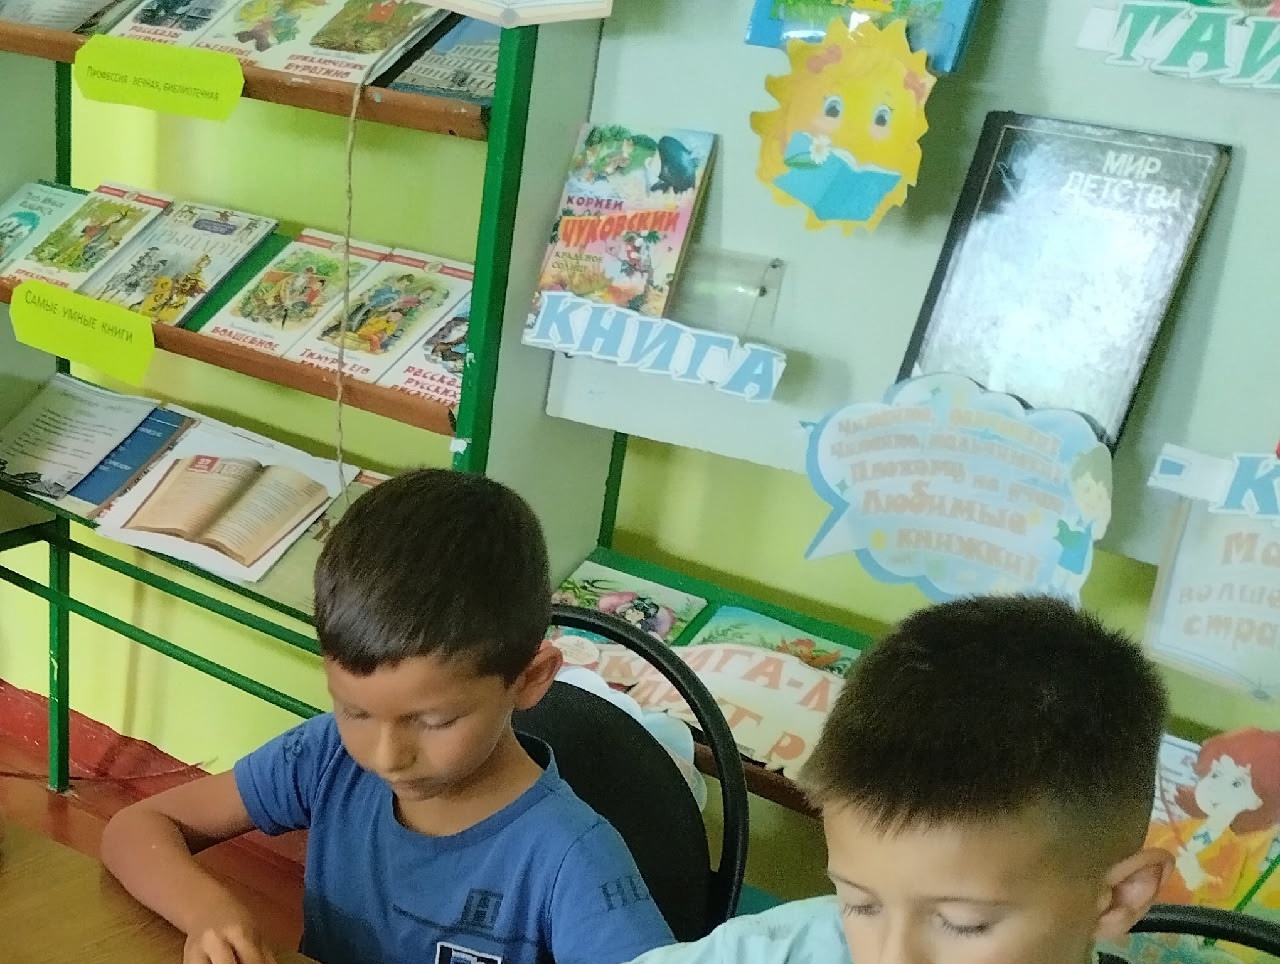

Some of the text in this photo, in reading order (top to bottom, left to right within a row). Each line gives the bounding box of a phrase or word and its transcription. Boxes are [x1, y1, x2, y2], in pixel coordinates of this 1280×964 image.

[1102, 150, 1162, 178] МИР
[1060, 171, 1183, 211] ДЕТСТВА
[532, 294, 780, 401] КНИГА
[1183, 613, 1280, 651] стра
